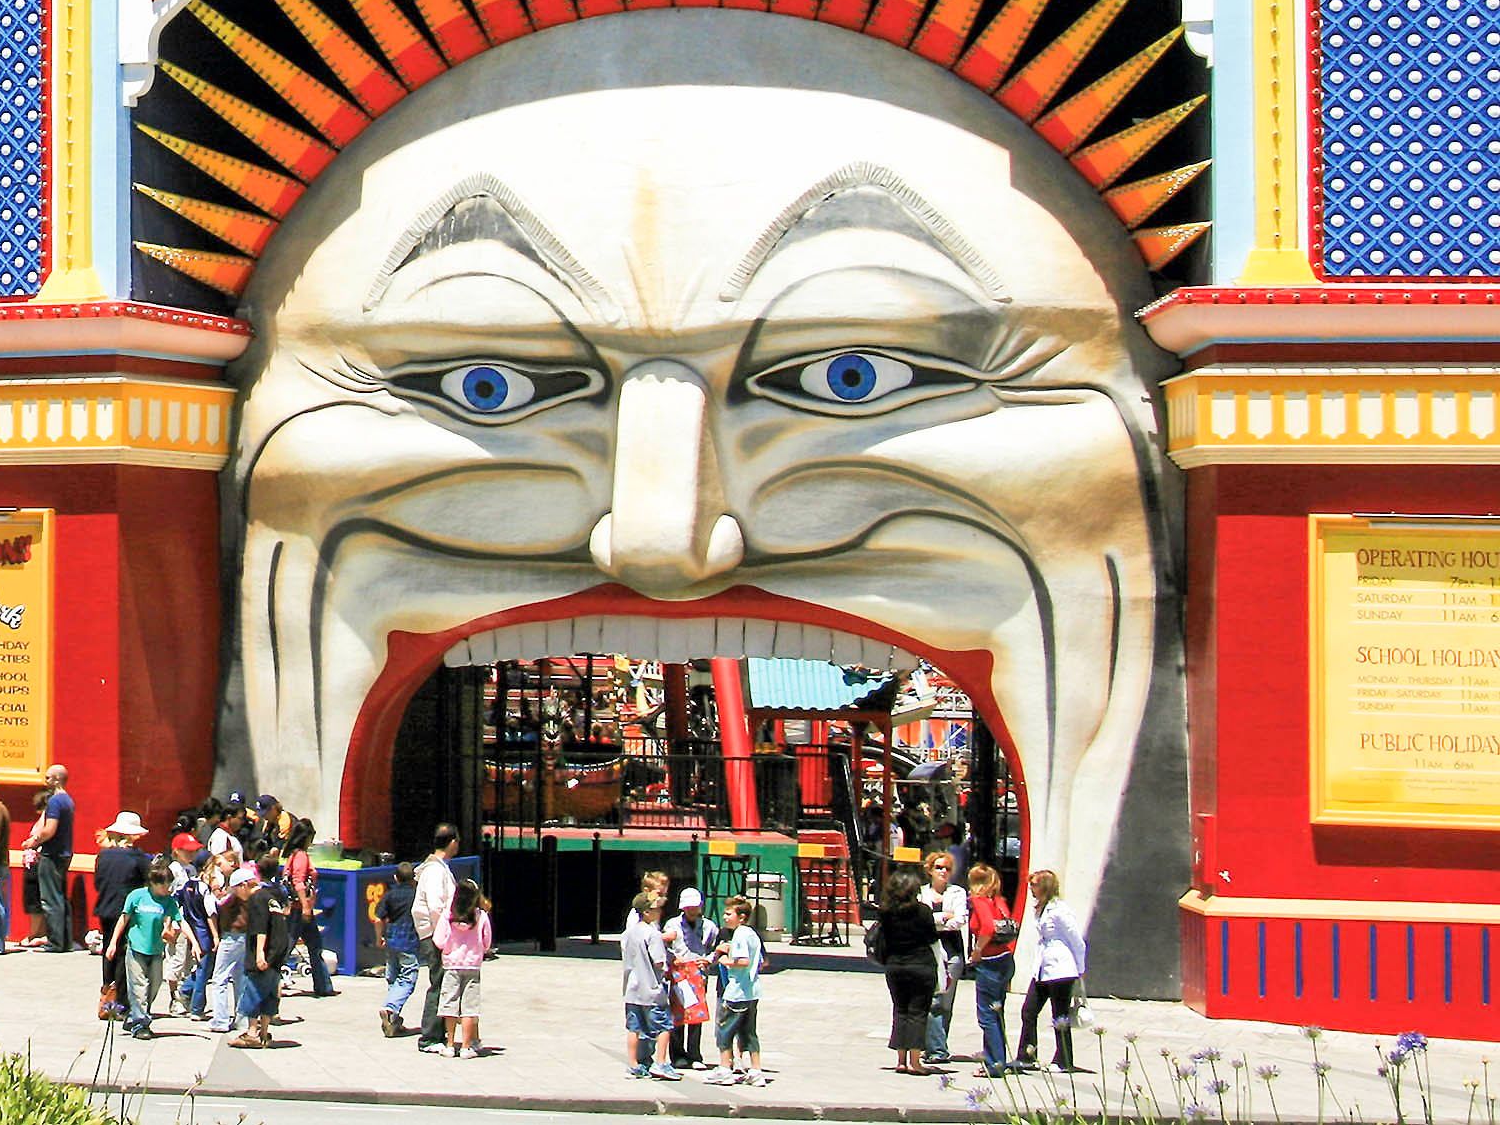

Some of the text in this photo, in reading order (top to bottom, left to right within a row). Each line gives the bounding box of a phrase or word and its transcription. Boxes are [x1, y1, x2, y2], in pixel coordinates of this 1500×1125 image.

[1356, 548, 1456, 569] OPERATING
[1357, 575, 1395, 587] FRIDAY
[1356, 592, 1413, 604] SATURDAY
[1356, 609, 1403, 620] SUNDAY
[1355, 646, 1427, 666] SCHOOL
[1357, 675, 1399, 684] MONDAY
[1407, 676, 1454, 685] THURSDAY
[1395, 689, 1442, 698] SATURDAY
[1357, 702, 1396, 711] SUNDAY
[1360, 733, 1424, 752] PUBLIC
